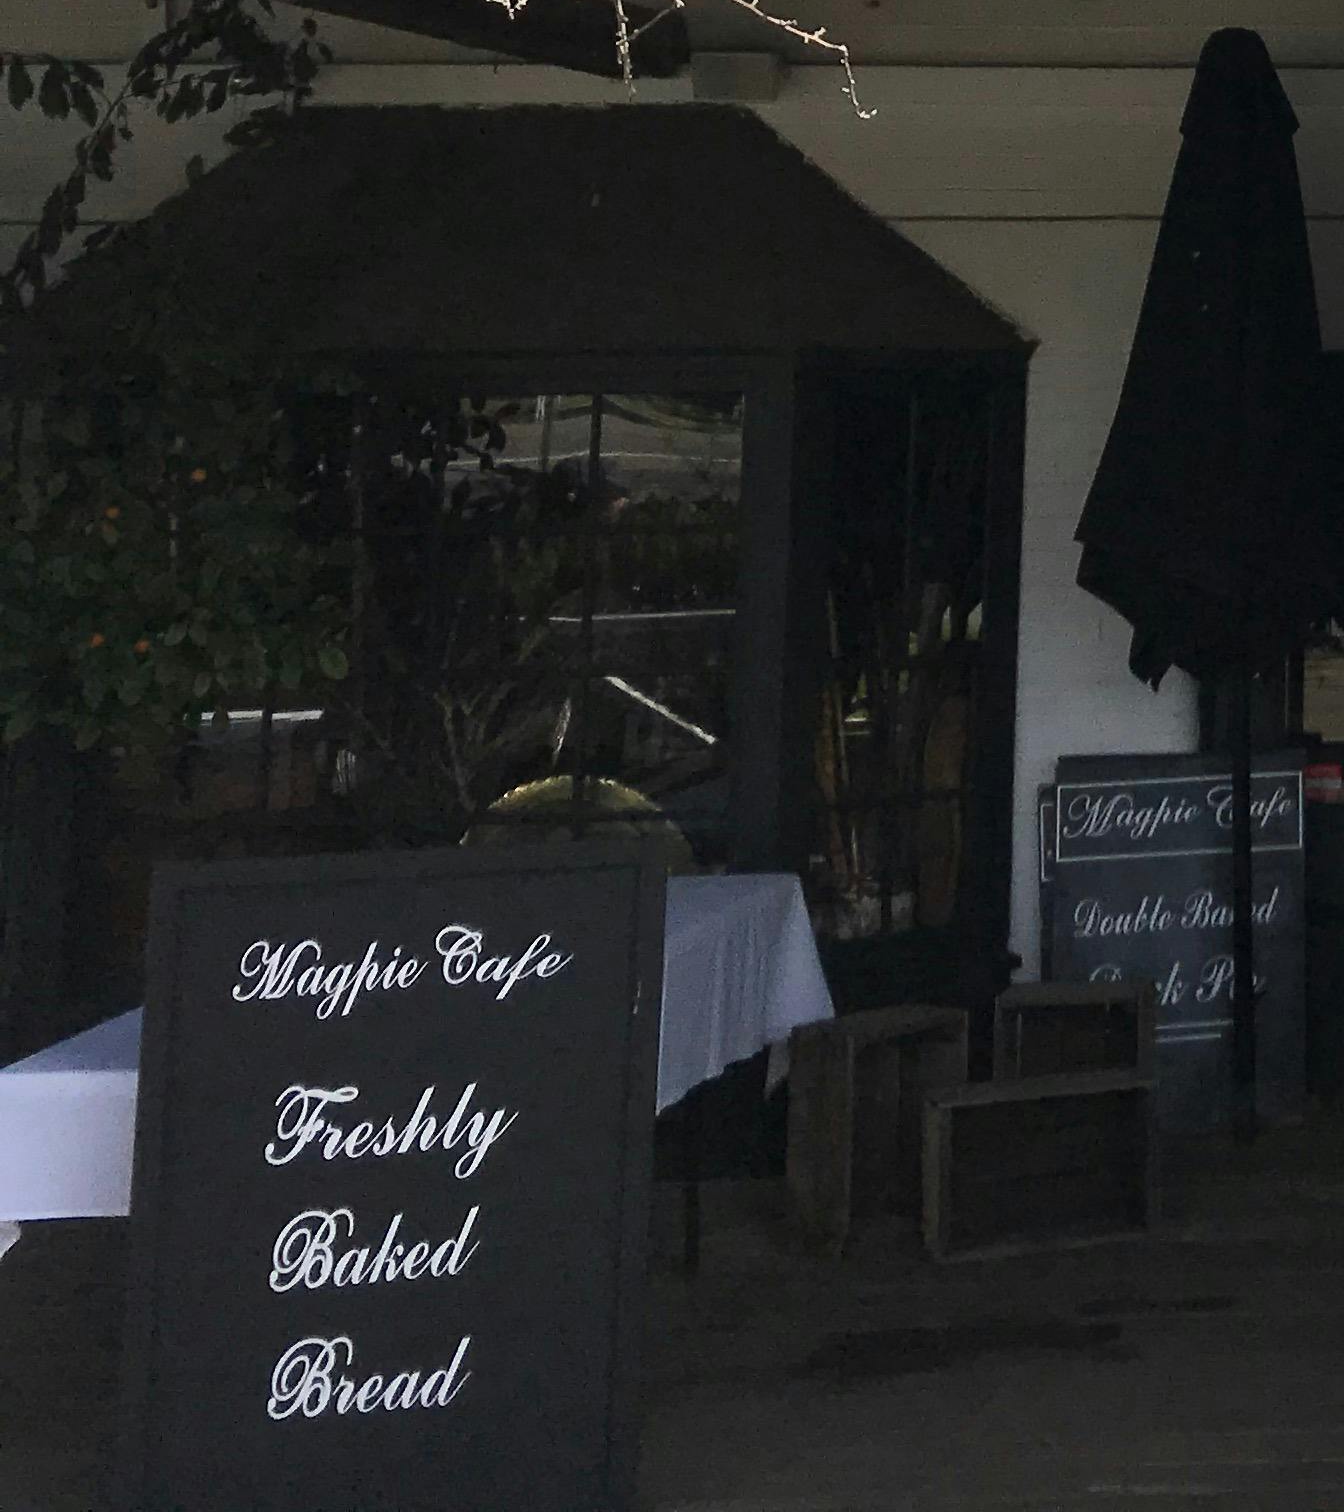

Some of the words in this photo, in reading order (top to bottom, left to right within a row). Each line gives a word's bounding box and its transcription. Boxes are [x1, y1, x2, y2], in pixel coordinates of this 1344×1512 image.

[1063, 793, 1199, 839] Magpie
[1073, 894, 1173, 938] Double
[232, 939, 430, 1020] Magpie
[436, 924, 575, 1000] Cafe
[264, 1082, 519, 1179] Freshly
[269, 1205, 480, 1292] Baked
[267, 1335, 474, 1421] Bread
